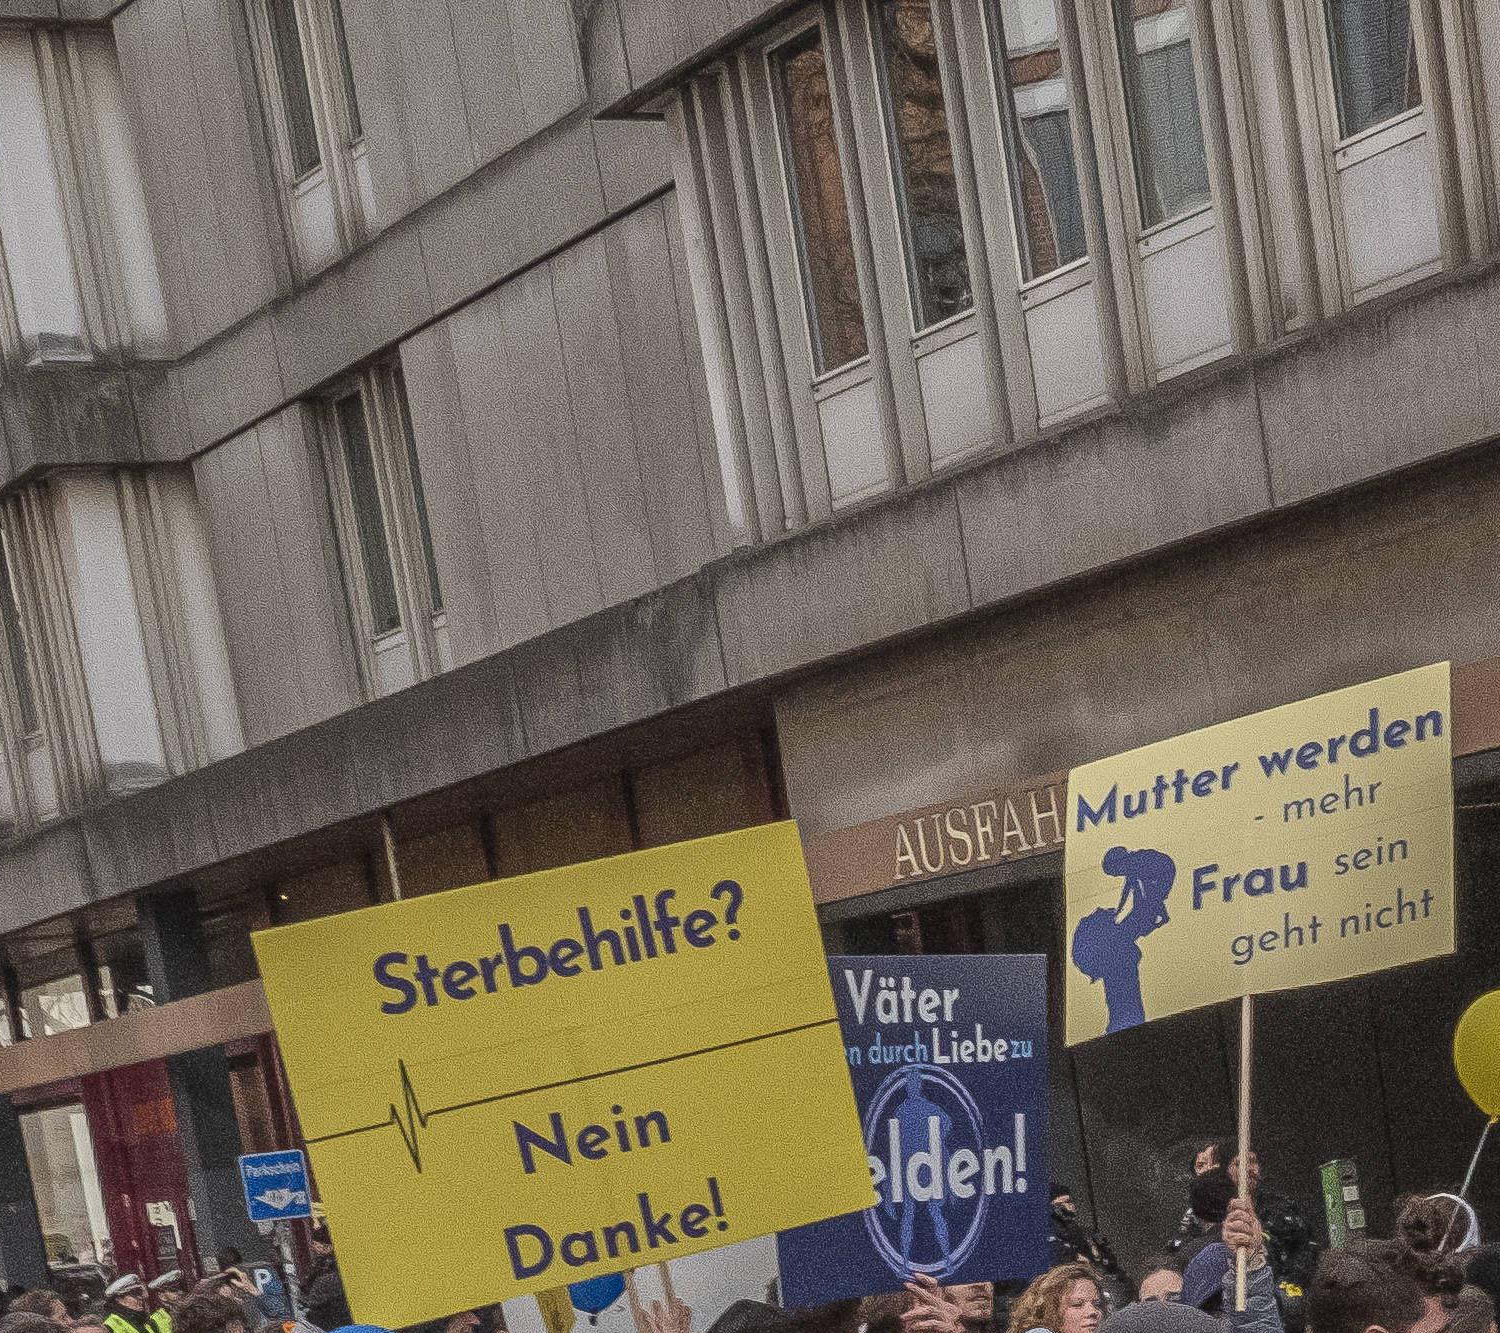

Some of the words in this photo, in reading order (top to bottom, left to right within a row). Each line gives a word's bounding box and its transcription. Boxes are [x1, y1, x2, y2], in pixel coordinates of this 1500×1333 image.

[1076, 763, 1240, 832] Mutter
[1257, 707, 1443, 779] werden
[1281, 776, 1383, 823] mehr
[893, 787, 1068, 880] AUSFAH
[1192, 859, 1309, 910] Frau
[1333, 837, 1410, 877] sein
[373, 879, 744, 1014] Sterbehilfe?
[1230, 914, 1323, 965] geht
[1339, 888, 1436, 938] nicht
[845, 969, 960, 1024] Väter
[868, 1031, 929, 1065] durch
[932, 1024, 1008, 1064] Liebe
[1010, 1038, 1033, 1058] zu
[512, 1104, 672, 1175] Nein
[504, 1177, 730, 1280] Danke!
